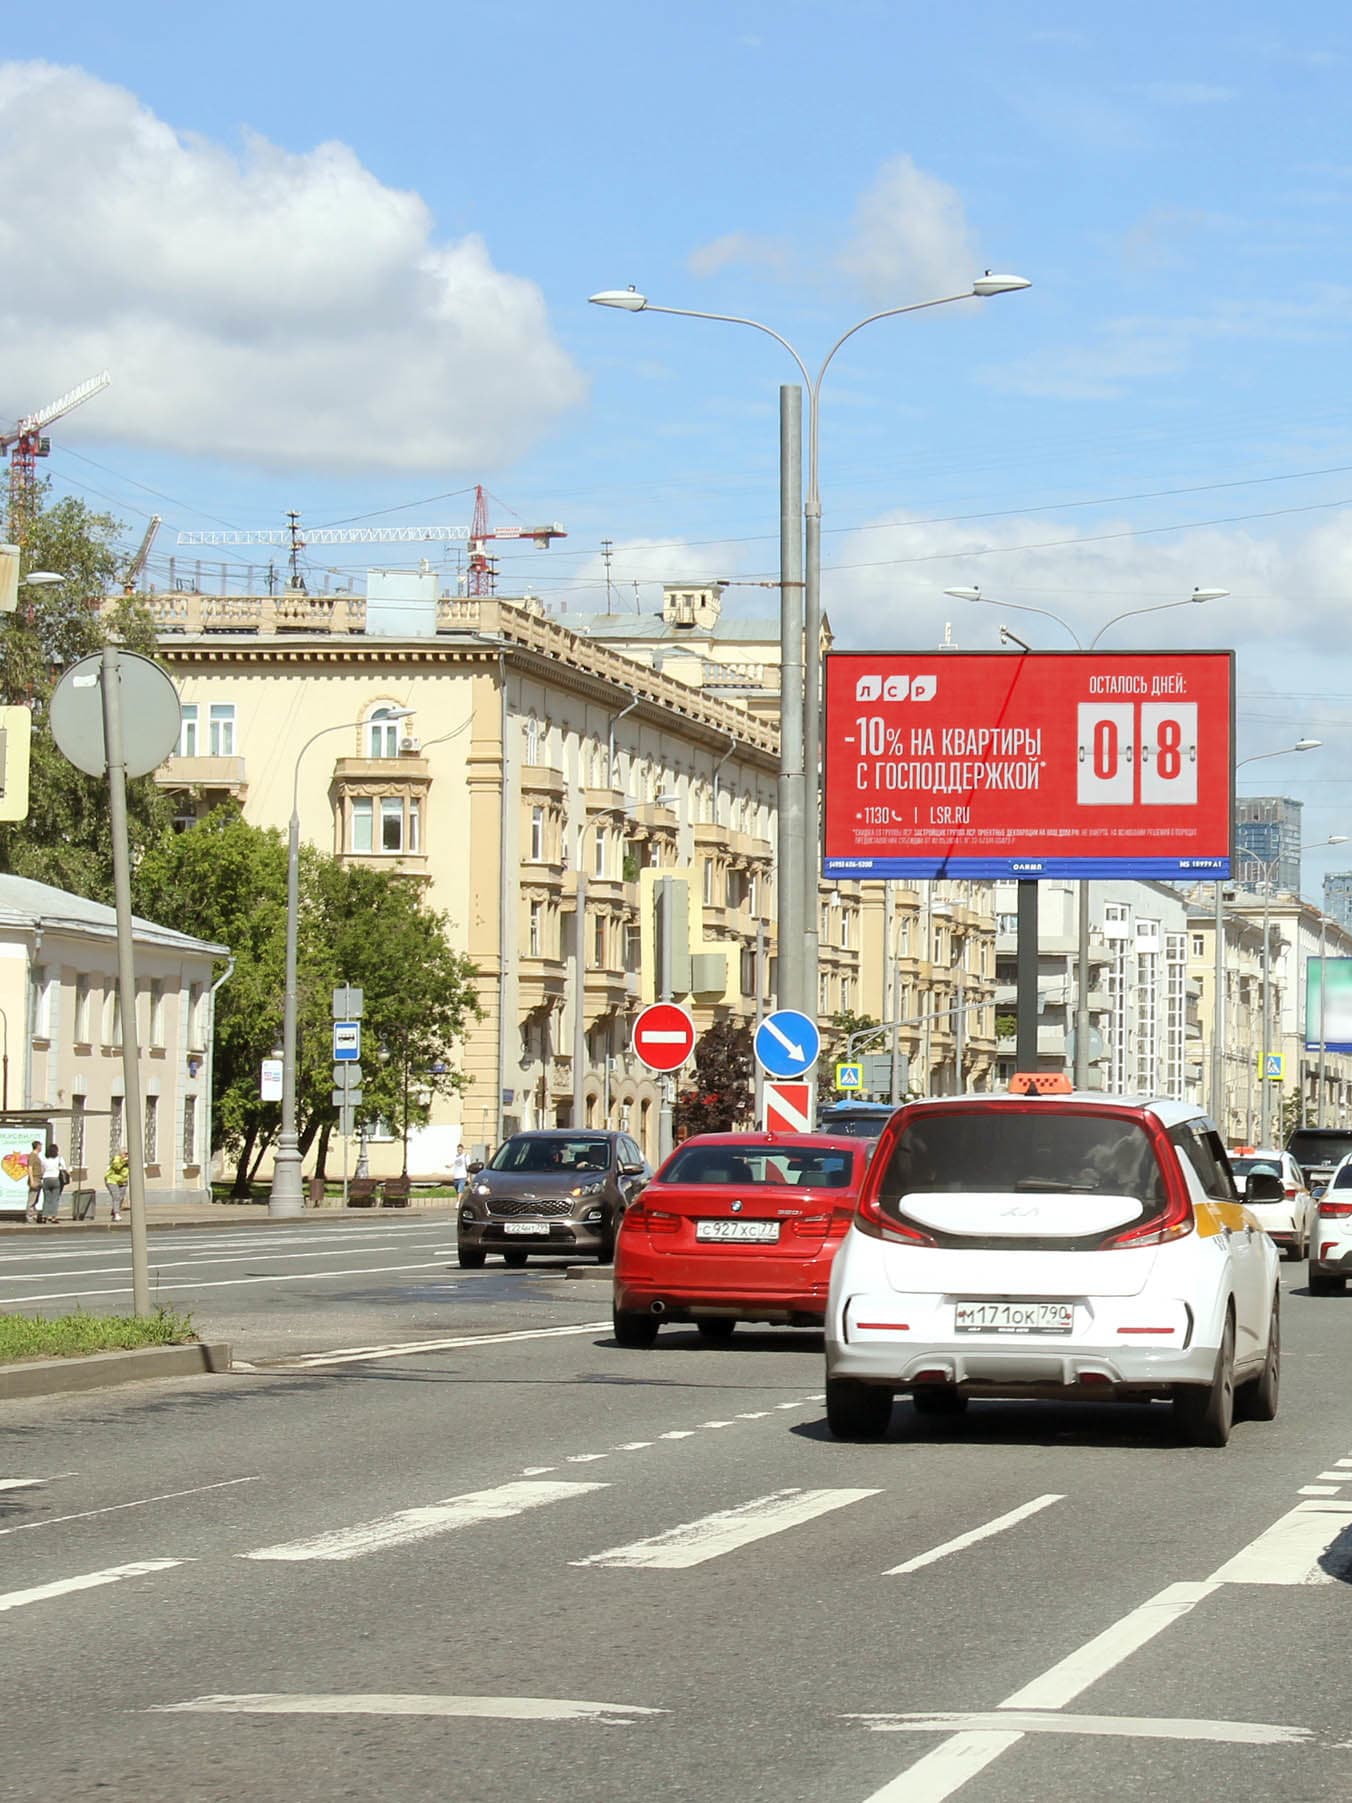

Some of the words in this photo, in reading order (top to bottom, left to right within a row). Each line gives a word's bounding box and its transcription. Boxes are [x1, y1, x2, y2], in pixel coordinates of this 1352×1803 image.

[1089, 676, 1147, 694] ОСТАЛОСЬ
[1151, 675, 1187, 696] ДНЕЙ:
[911, 729, 934, 755] НА
[942, 727, 1041, 755] КВАРТИРЫ
[857, 762, 869, 790] С
[930, 807, 970, 824] LSR.RU
